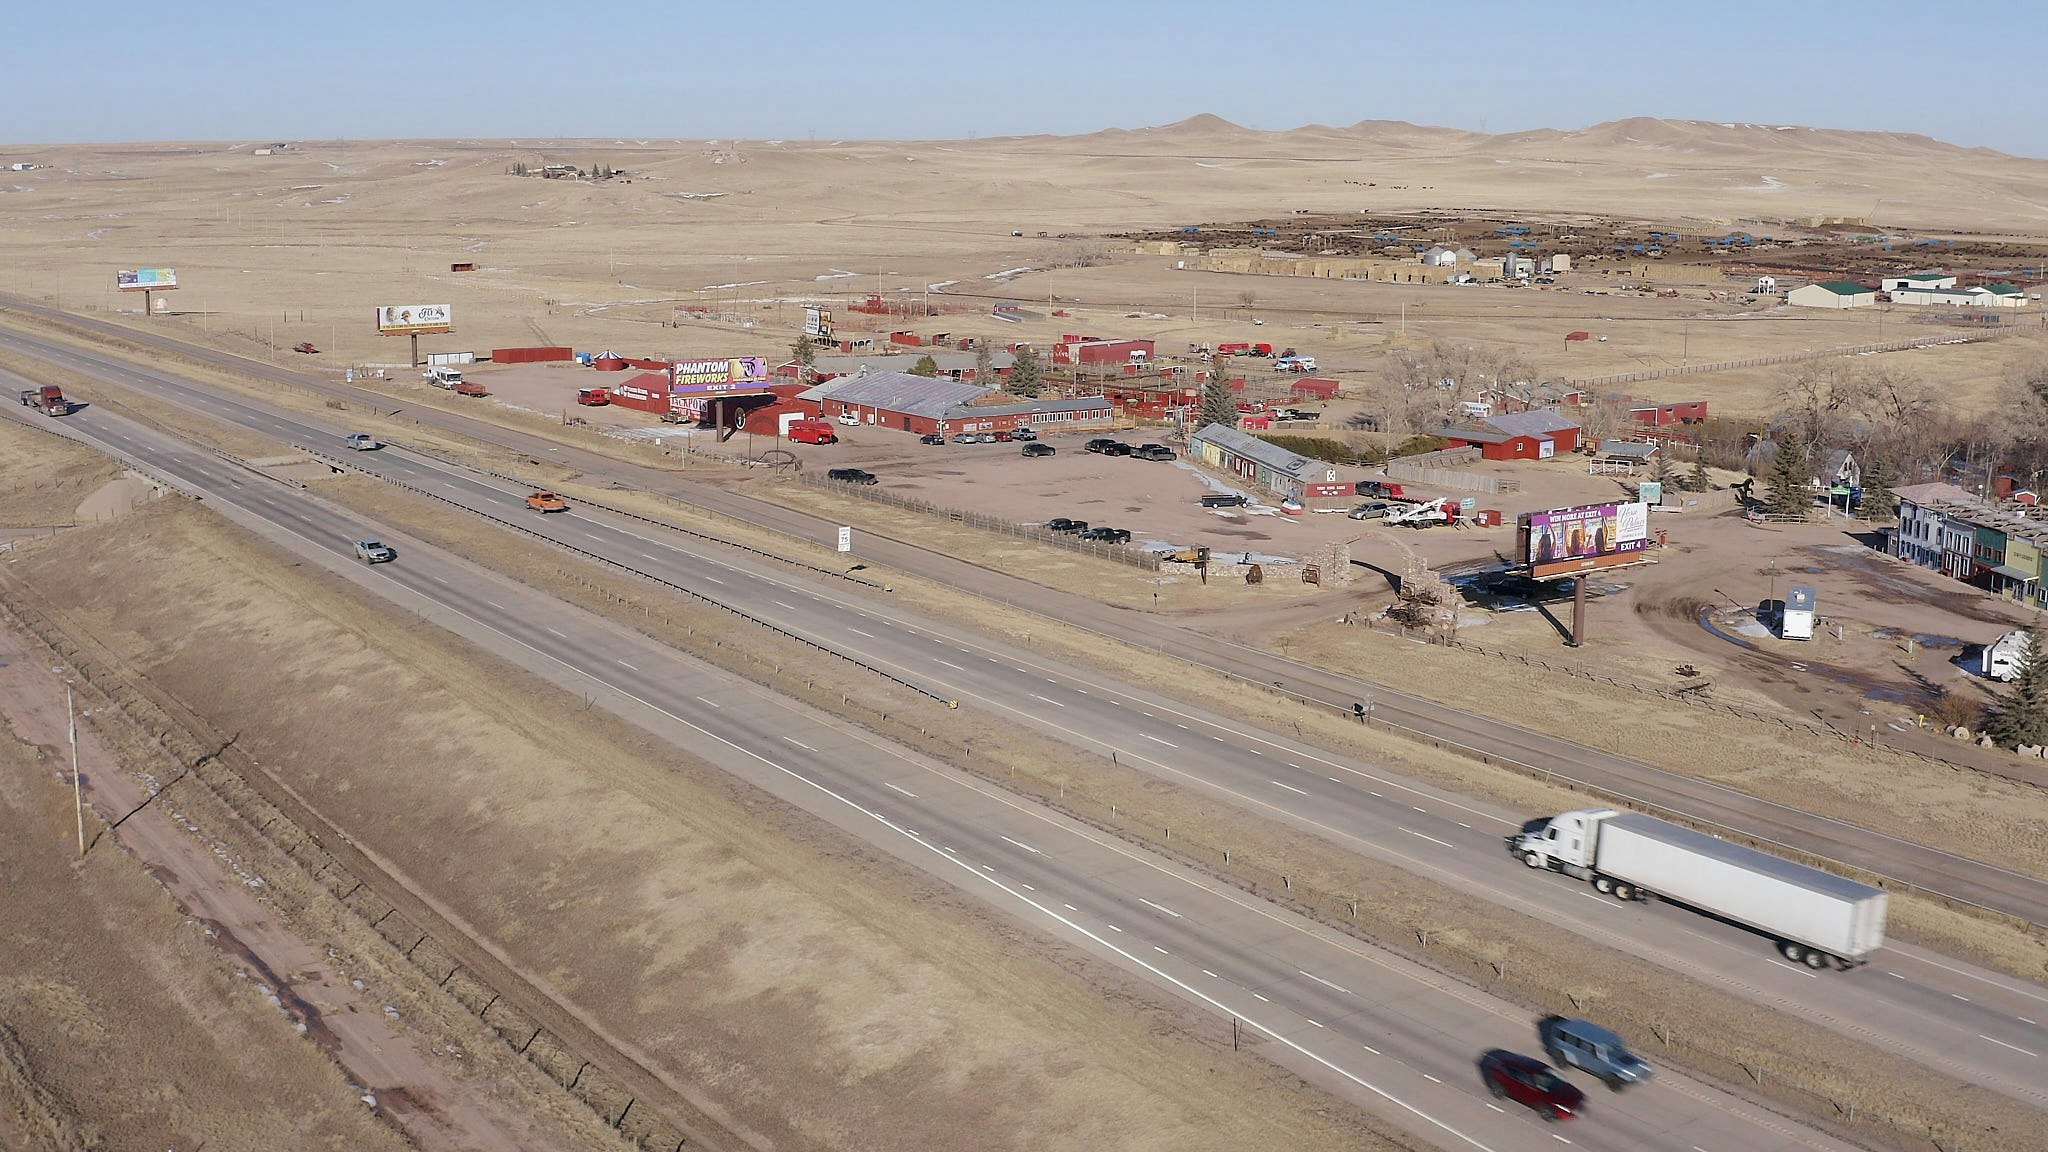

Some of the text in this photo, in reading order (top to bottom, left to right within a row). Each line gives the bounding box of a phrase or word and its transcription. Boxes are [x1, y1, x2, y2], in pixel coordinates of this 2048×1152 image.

[676, 361, 728, 374] PHANTOM
[675, 373, 729, 385] FIREWORKS
[671, 397, 708, 412] JACKPOTS
[1549, 515, 1561, 523] WIN
[1562, 513, 1577, 521] MORE
[1585, 510, 1598, 518] EXIT
[1620, 542, 1635, 551] EXIT
